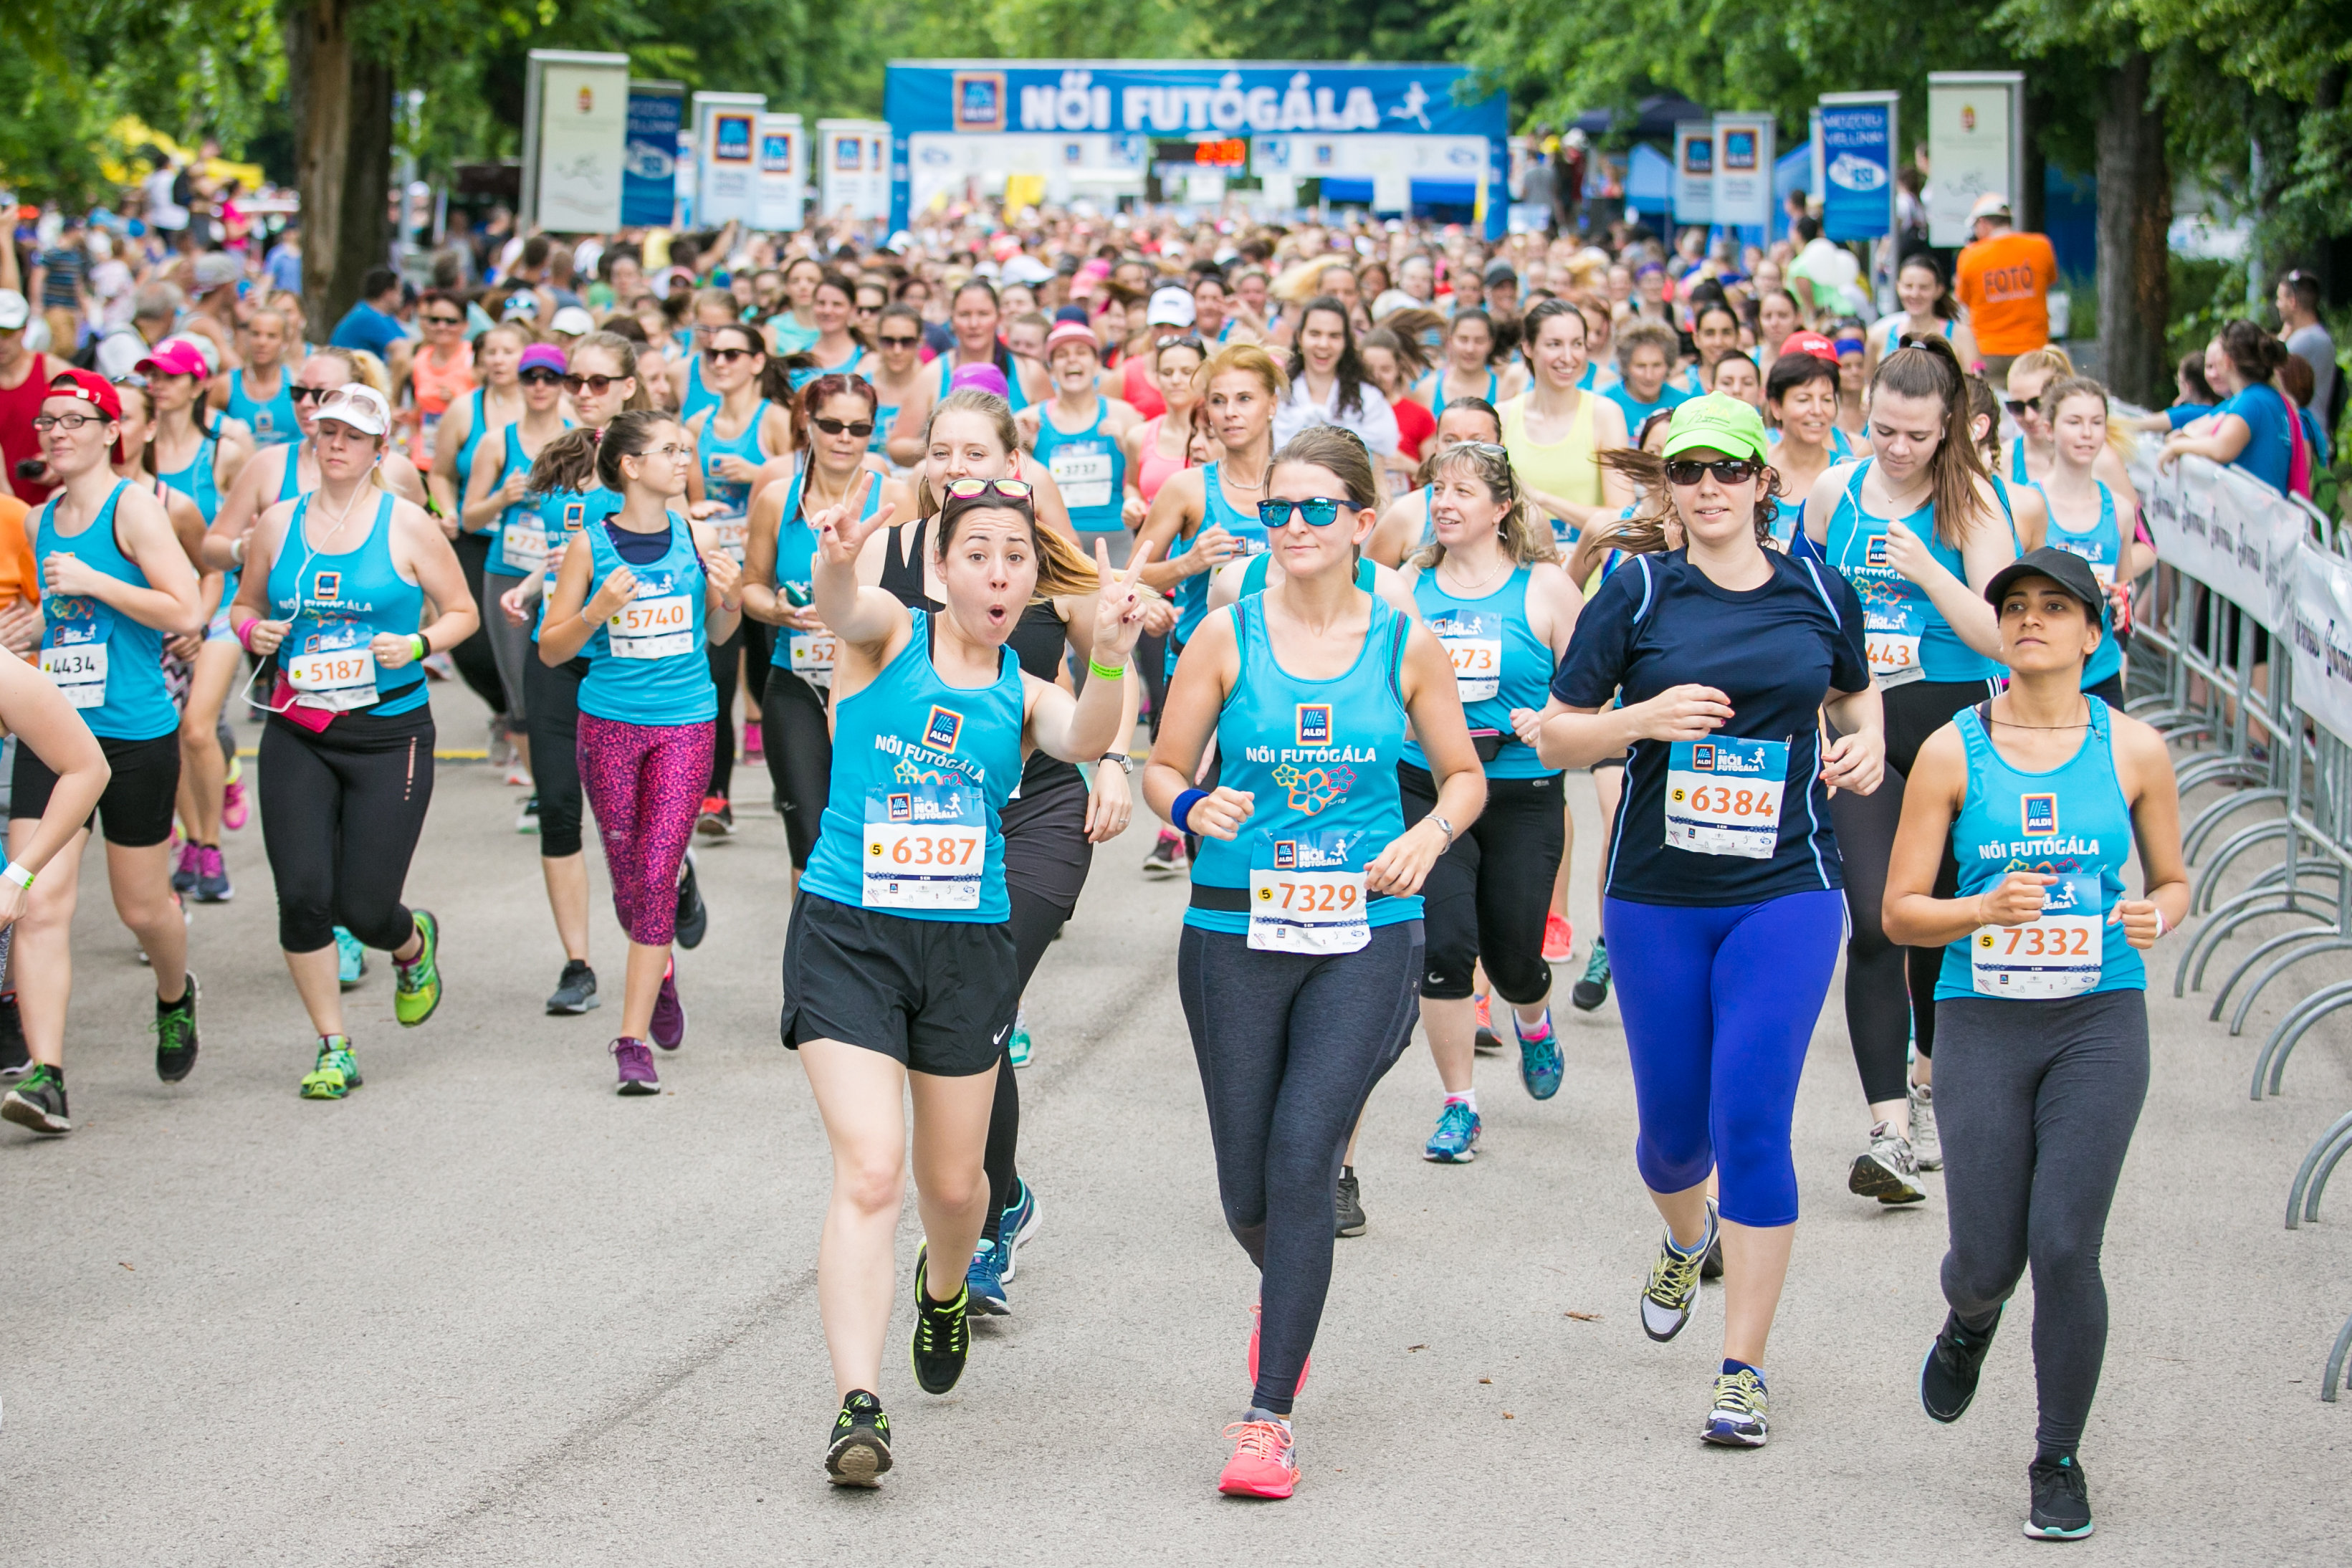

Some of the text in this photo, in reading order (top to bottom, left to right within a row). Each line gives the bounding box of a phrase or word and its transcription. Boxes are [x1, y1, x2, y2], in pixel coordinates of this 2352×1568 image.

[1020, 70, 1380, 130] NŐI FUTÓGÁLA
[1983, 257, 2034, 296] FOTÓ
[626, 606, 684, 628] 5740
[53, 656, 95, 674] 4434
[310, 659, 365, 682] 5187
[929, 730, 952, 744] ALDI
[1302, 727, 1326, 737] ALDI
[874, 734, 985, 784] NŐI FUTÓGÁLA
[1246, 744, 1377, 763] NŐI FUTÓGÁLA
[1717, 753, 1742, 766] NŐI
[914, 800, 940, 813] NŐI
[1674, 785, 1774, 817] 5 6384
[2028, 818, 2052, 827] ALDI
[872, 836, 977, 866] 5 6387
[1299, 847, 1325, 861] NŐI
[1978, 835, 2100, 860] NŐI FUTÓGÁLA
[1261, 882, 1357, 912] 5 7329
[1982, 927, 2089, 956] 5 7332
